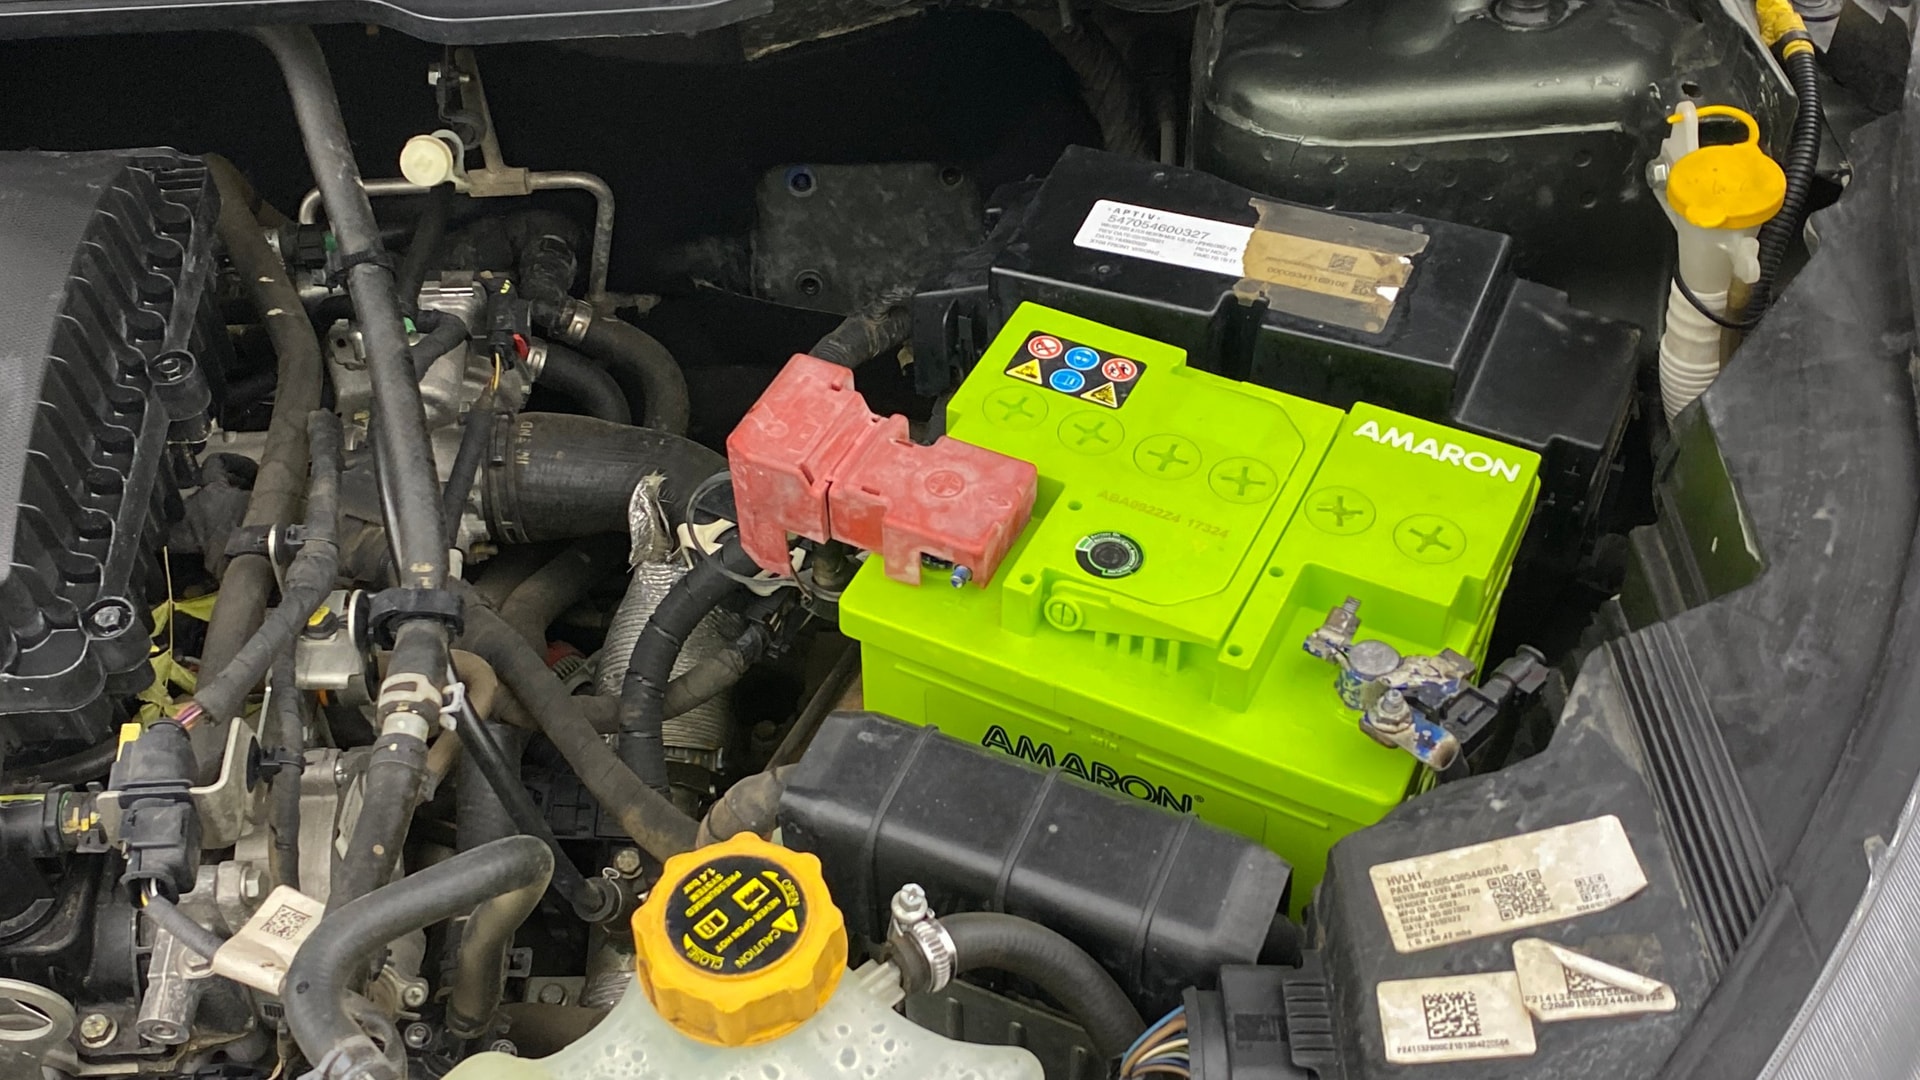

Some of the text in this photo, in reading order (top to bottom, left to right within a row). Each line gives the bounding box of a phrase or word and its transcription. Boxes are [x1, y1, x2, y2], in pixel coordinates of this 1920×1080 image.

[1108, 214, 1210, 240] 547054600327
[1113, 207, 1156, 220] APTIV
[1353, 420, 1521, 482] AMARON
[1187, 518, 1230, 538] 17324
[981, 724, 1194, 814] AMARON
[689, 873, 724, 902] SYSTEM
[782, 879, 800, 908] OPEN
[1390, 884, 1415, 896] PART
[715, 896, 781, 953] NEVER OPEN HOT
[686, 944, 725, 970] CLOSE
[734, 929, 781, 968] CAUTION
